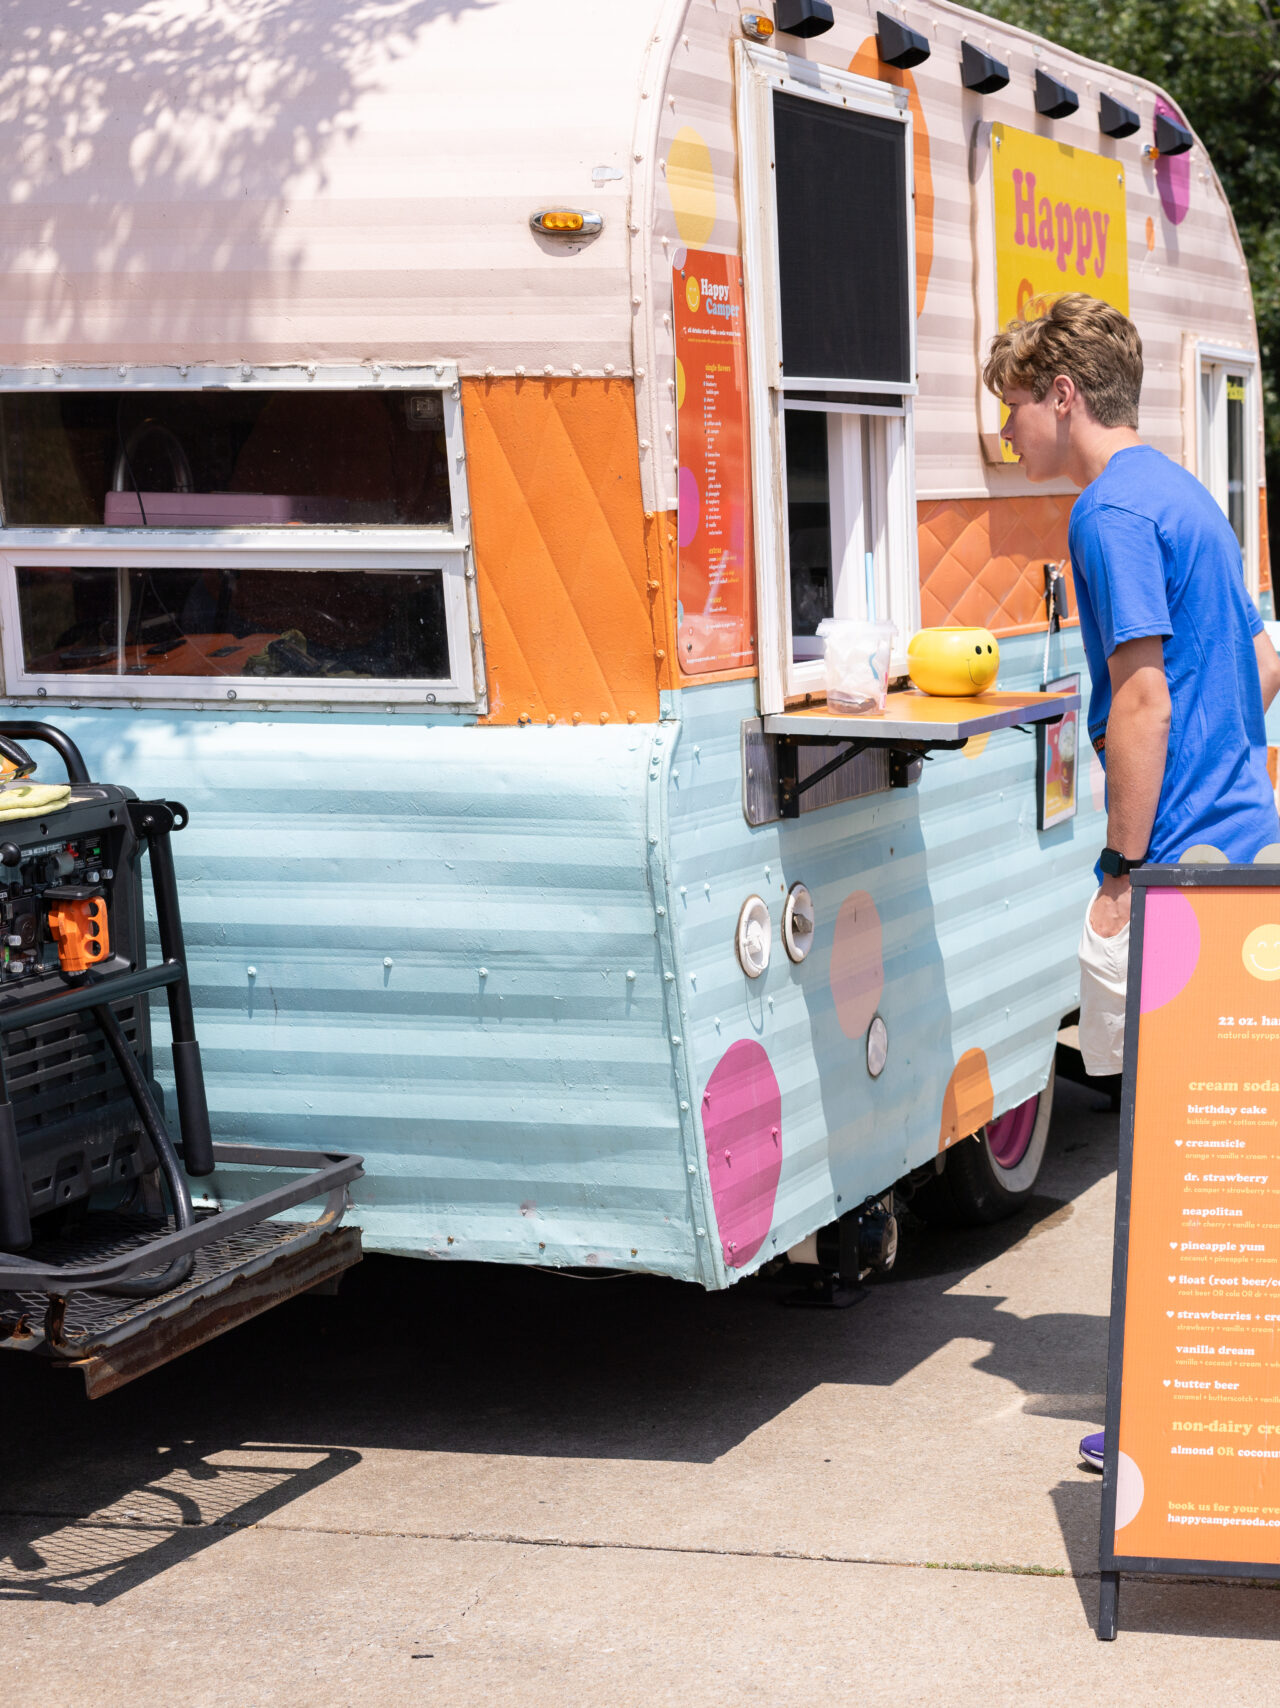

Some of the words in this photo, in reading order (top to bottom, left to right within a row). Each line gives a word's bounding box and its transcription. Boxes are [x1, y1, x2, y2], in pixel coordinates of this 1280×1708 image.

[1012, 168, 1110, 279] Happy
[700, 278, 730, 301] Happy
[705, 297, 740, 321] Camper
[1218, 1016, 1235, 1026] 22
[1238, 1017, 1258, 1026] oz.
[1218, 1031, 1250, 1040] natural
[1252, 1033, 1280, 1041] syrups
[1189, 1082, 1238, 1091] cream
[1187, 1104, 1237, 1116] birthday
[1240, 1105, 1267, 1114] cake
[1257, 1119, 1278, 1127] candy
[1185, 1139, 1246, 1148] creamsicle
[1184, 1172, 1200, 1181] dr.
[1203, 1173, 1268, 1184] strawberry
[1227, 1187, 1264, 1195] strawberry
[1182, 1207, 1243, 1217] neapolitan
[1180, 1240, 1237, 1252] pineapple
[1239, 1244, 1265, 1253] yum
[1214, 1255, 1248, 1264] pineapple
[1179, 1275, 1205, 1285] float
[1208, 1275, 1239, 1286] (root
[1177, 1310, 1251, 1320] strawberries
[1177, 1324, 1215, 1332] strawberry
[1251, 1325, 1275, 1334] cream
[1176, 1345, 1215, 1354] vanilla
[1218, 1345, 1255, 1355] dream
[1174, 1379, 1211, 1389] butter
[1214, 1380, 1240, 1390] beer
[1208, 1393, 1253, 1402] butterscotch
[1172, 1420, 1253, 1436] non-dairy
[1171, 1445, 1214, 1456] almond
[1217, 1447, 1234, 1456] OR
[1168, 1501, 1195, 1510] book
[1213, 1503, 1230, 1512] for
[1233, 1506, 1259, 1514] your
